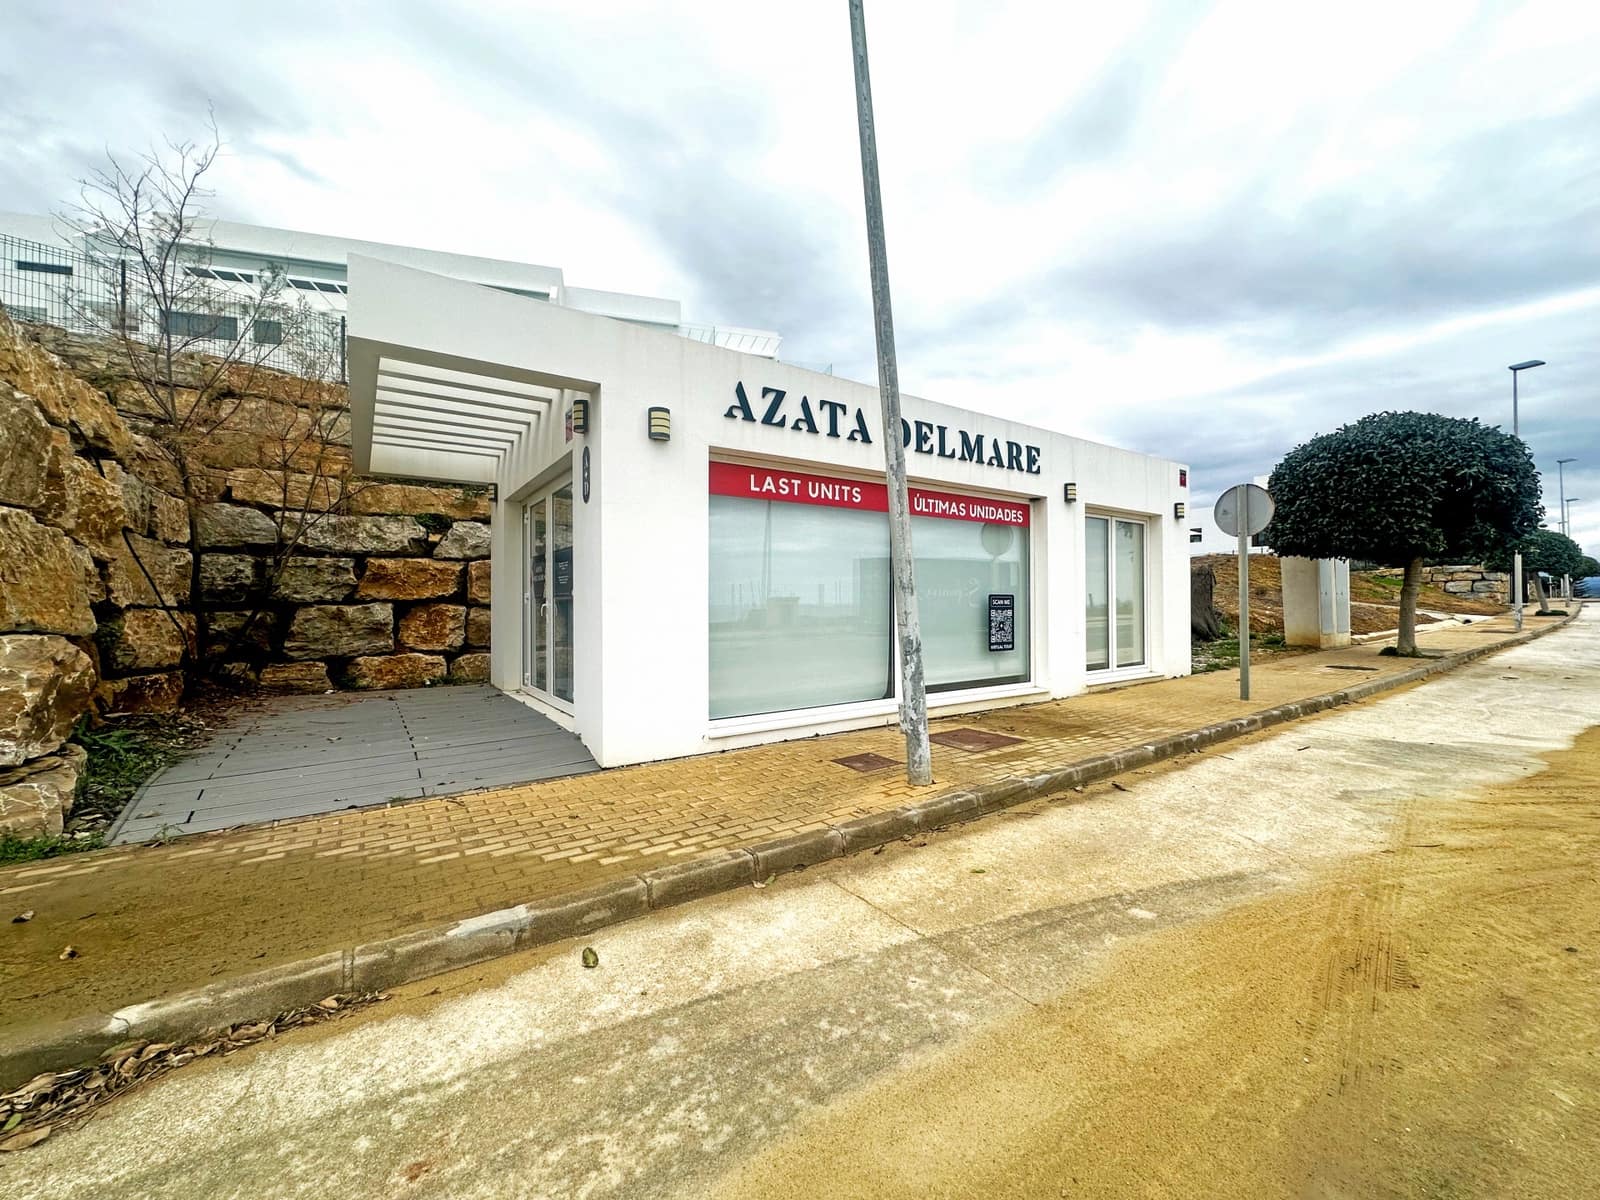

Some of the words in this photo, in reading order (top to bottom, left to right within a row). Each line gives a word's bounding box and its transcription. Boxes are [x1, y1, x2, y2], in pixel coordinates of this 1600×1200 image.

[723, 381, 873, 443] AZATA
[750, 474, 801, 496] LAST
[808, 481, 861, 503] UNITS
[913, 493, 966, 516] ÚLTIMAS
[969, 504, 1023, 523] UNIDADES
